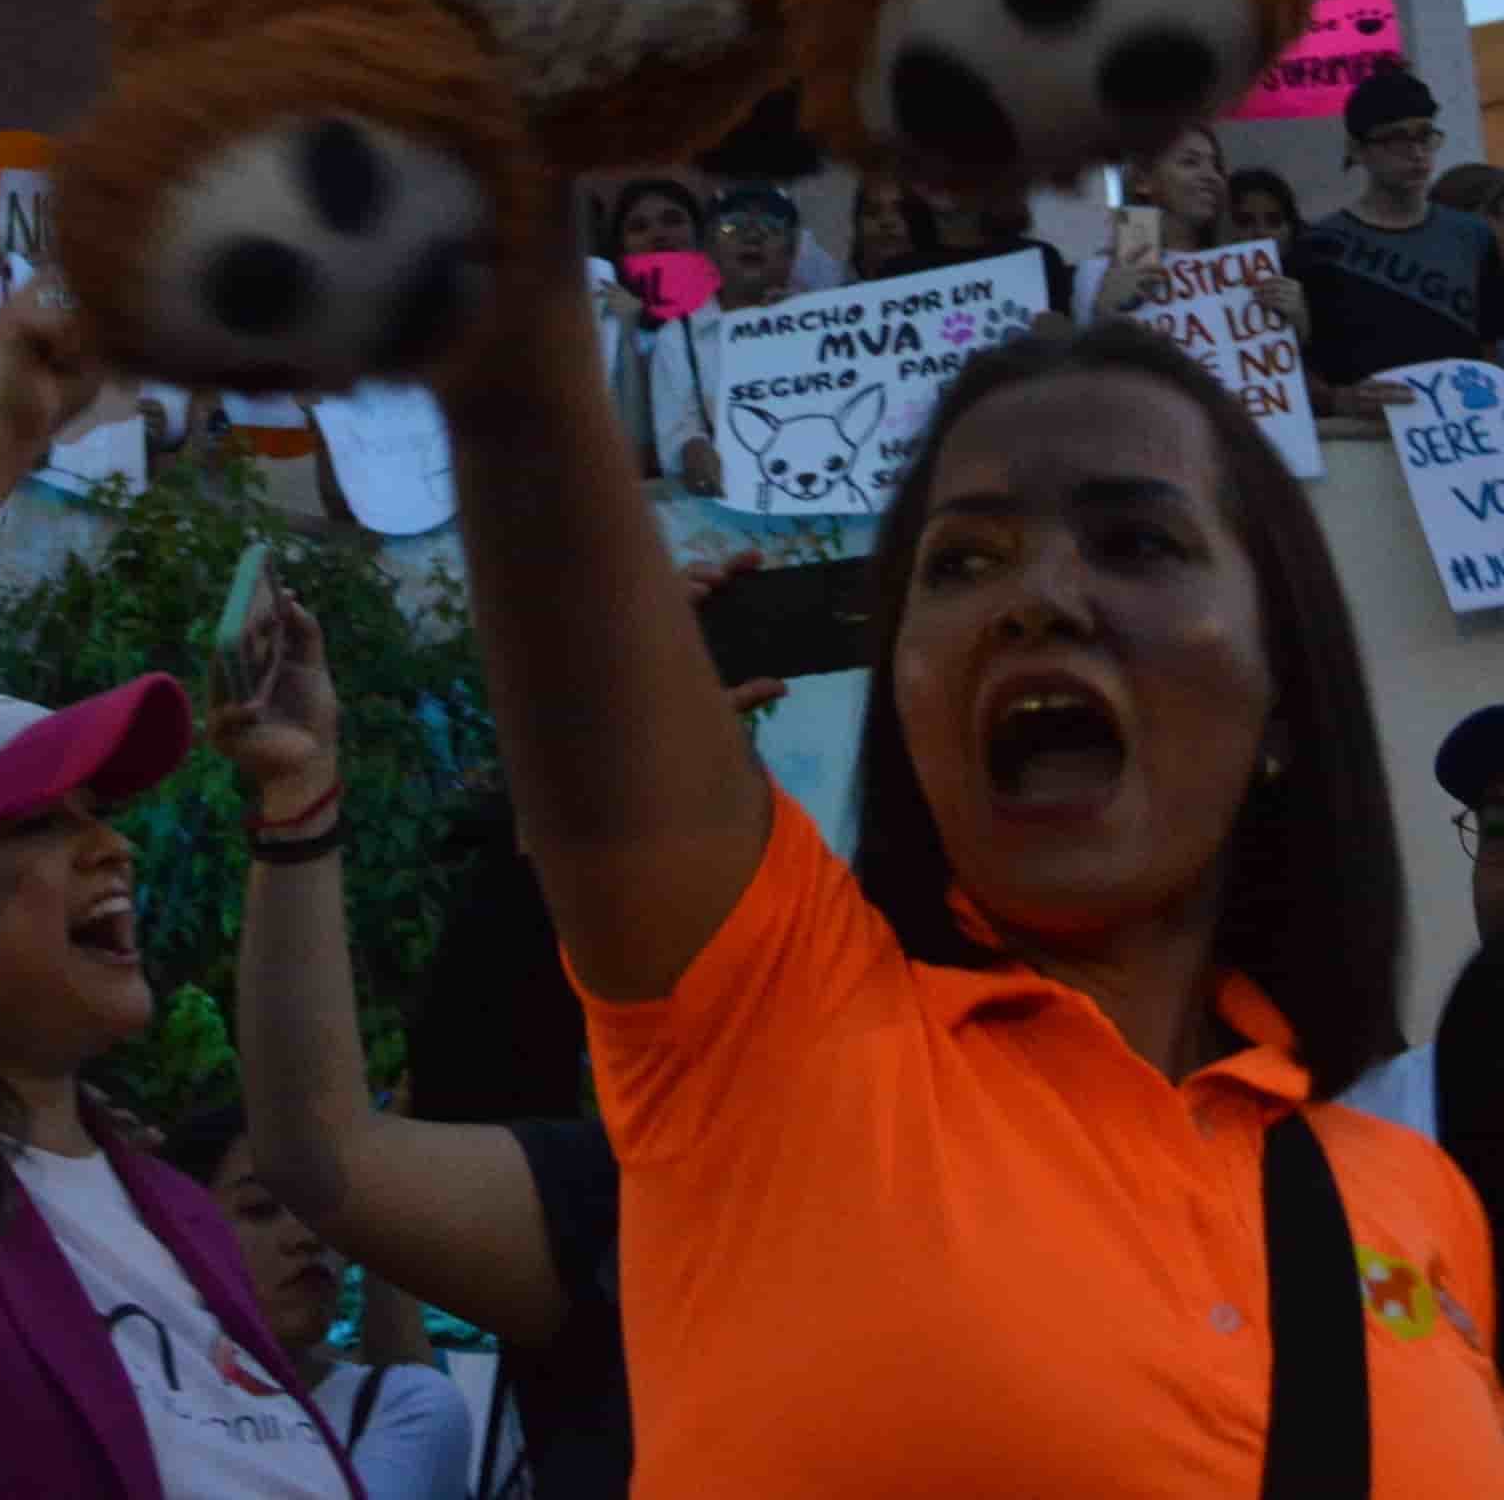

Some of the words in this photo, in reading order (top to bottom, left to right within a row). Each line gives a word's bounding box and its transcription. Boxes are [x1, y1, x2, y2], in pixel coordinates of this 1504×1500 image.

[882, 289, 944, 318] POR
[952, 280, 994, 306] UN
[1151, 248, 1274, 306] USTICIA
[730, 368, 859, 402] SEGURO
[899, 352, 968, 382] PAR
[1239, 340, 1298, 382] NO
